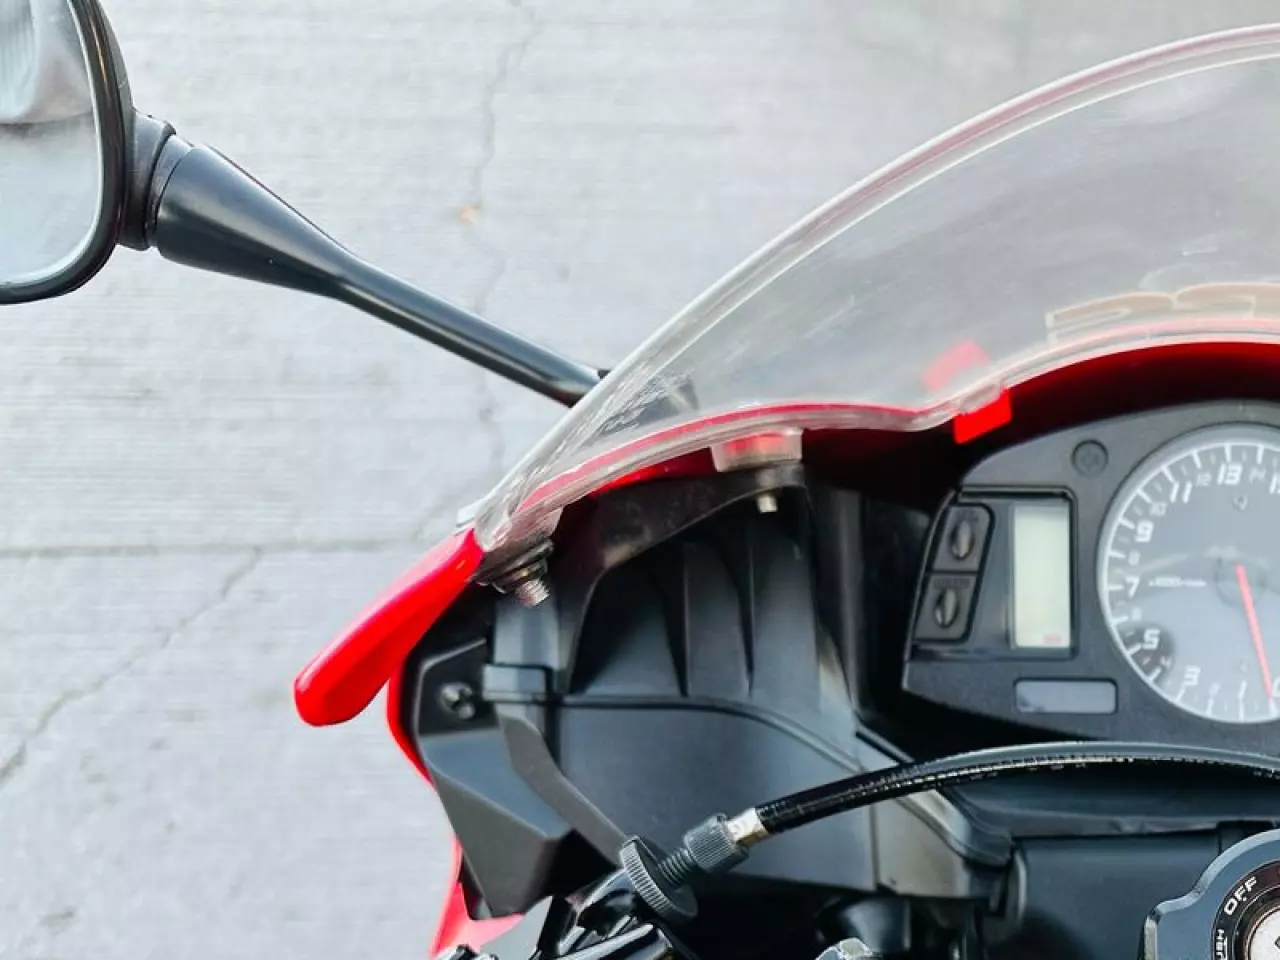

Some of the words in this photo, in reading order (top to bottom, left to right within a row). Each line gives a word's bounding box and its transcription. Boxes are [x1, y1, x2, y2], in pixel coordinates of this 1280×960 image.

[1217, 464, 1243, 485] 13
[1169, 481, 1192, 503] 11
[1135, 520, 1154, 543] 9
[1125, 576, 1140, 598] 7
[1142, 628, 1160, 650] 5
[1183, 665, 1201, 686] 3
[1223, 876, 1258, 916] OFF
